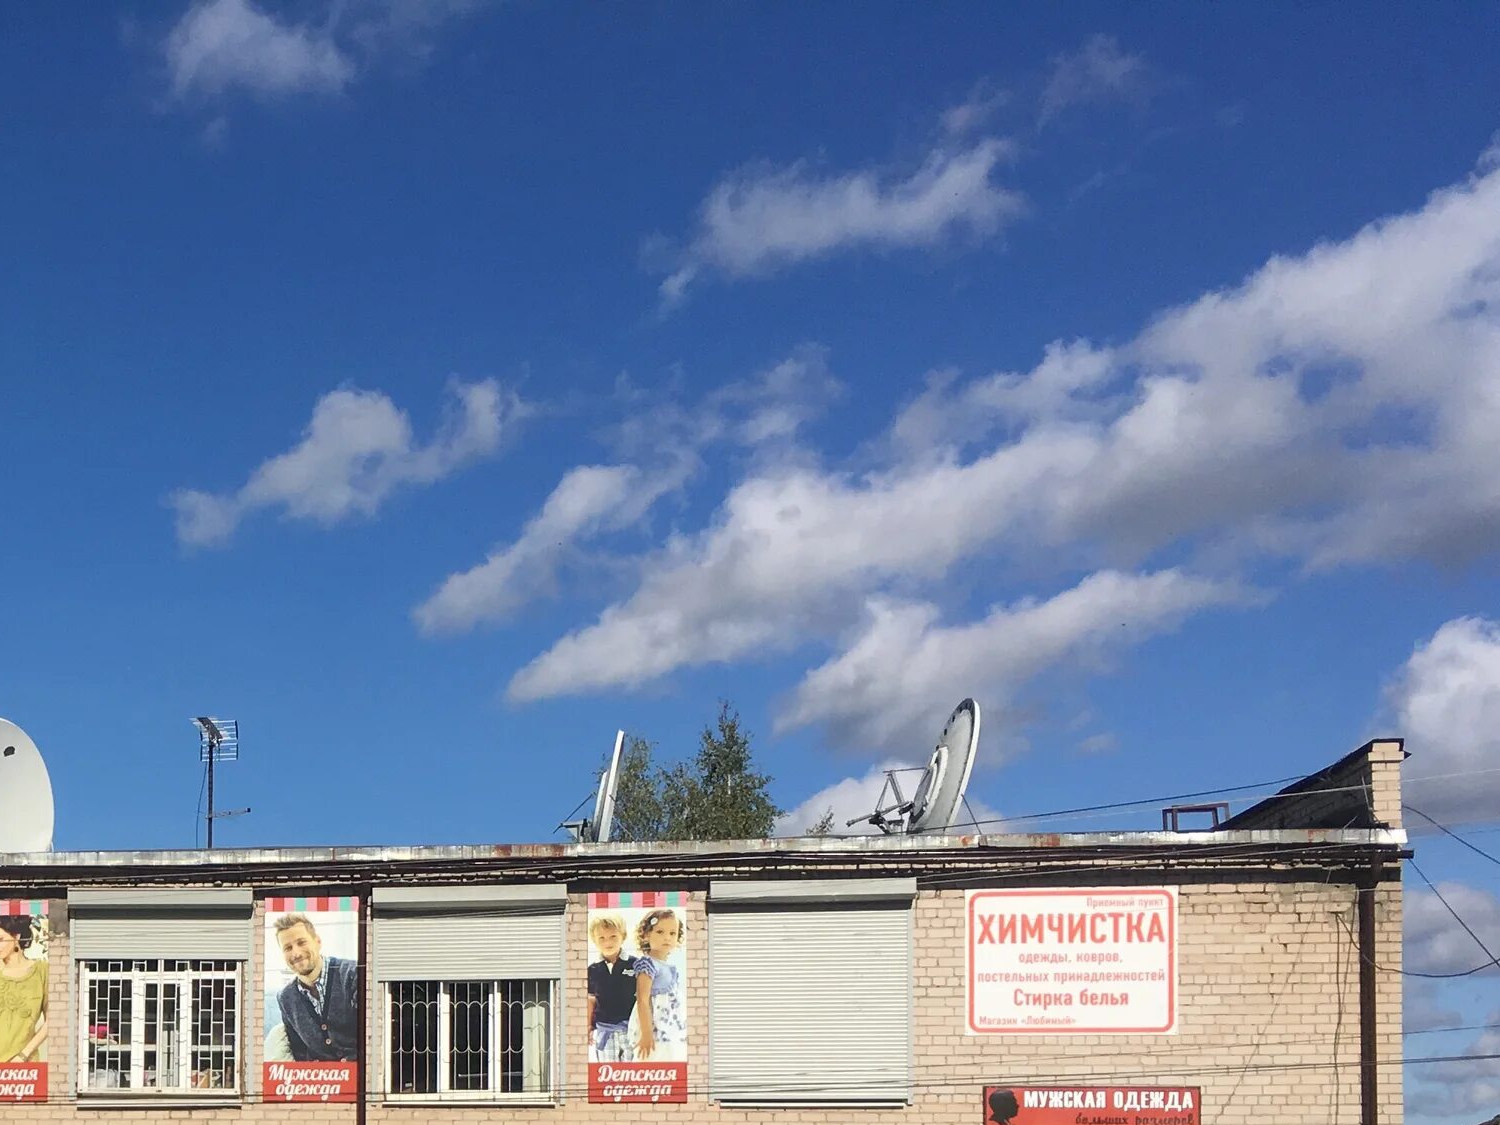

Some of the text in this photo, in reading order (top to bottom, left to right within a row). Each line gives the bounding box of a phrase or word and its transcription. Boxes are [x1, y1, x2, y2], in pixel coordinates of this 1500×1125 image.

[1137, 898, 1164, 909] пункт
[977, 912, 1165, 944] ХИМЧИСТКА
[977, 968, 1166, 984] постельных принадлежностей
[1013, 988, 1129, 1010] Стирка белья
[979, 1016, 1018, 1026] Магазин
[268, 1064, 350, 1085] Мужская
[597, 1064, 677, 1082] Детская
[275, 1083, 341, 1101] одежда
[603, 1084, 673, 1102] одежда
[1023, 1090, 1194, 1112] МУЖСКАЯ ОДЕЖДА
[1075, 1112, 1129, 1125] больших
